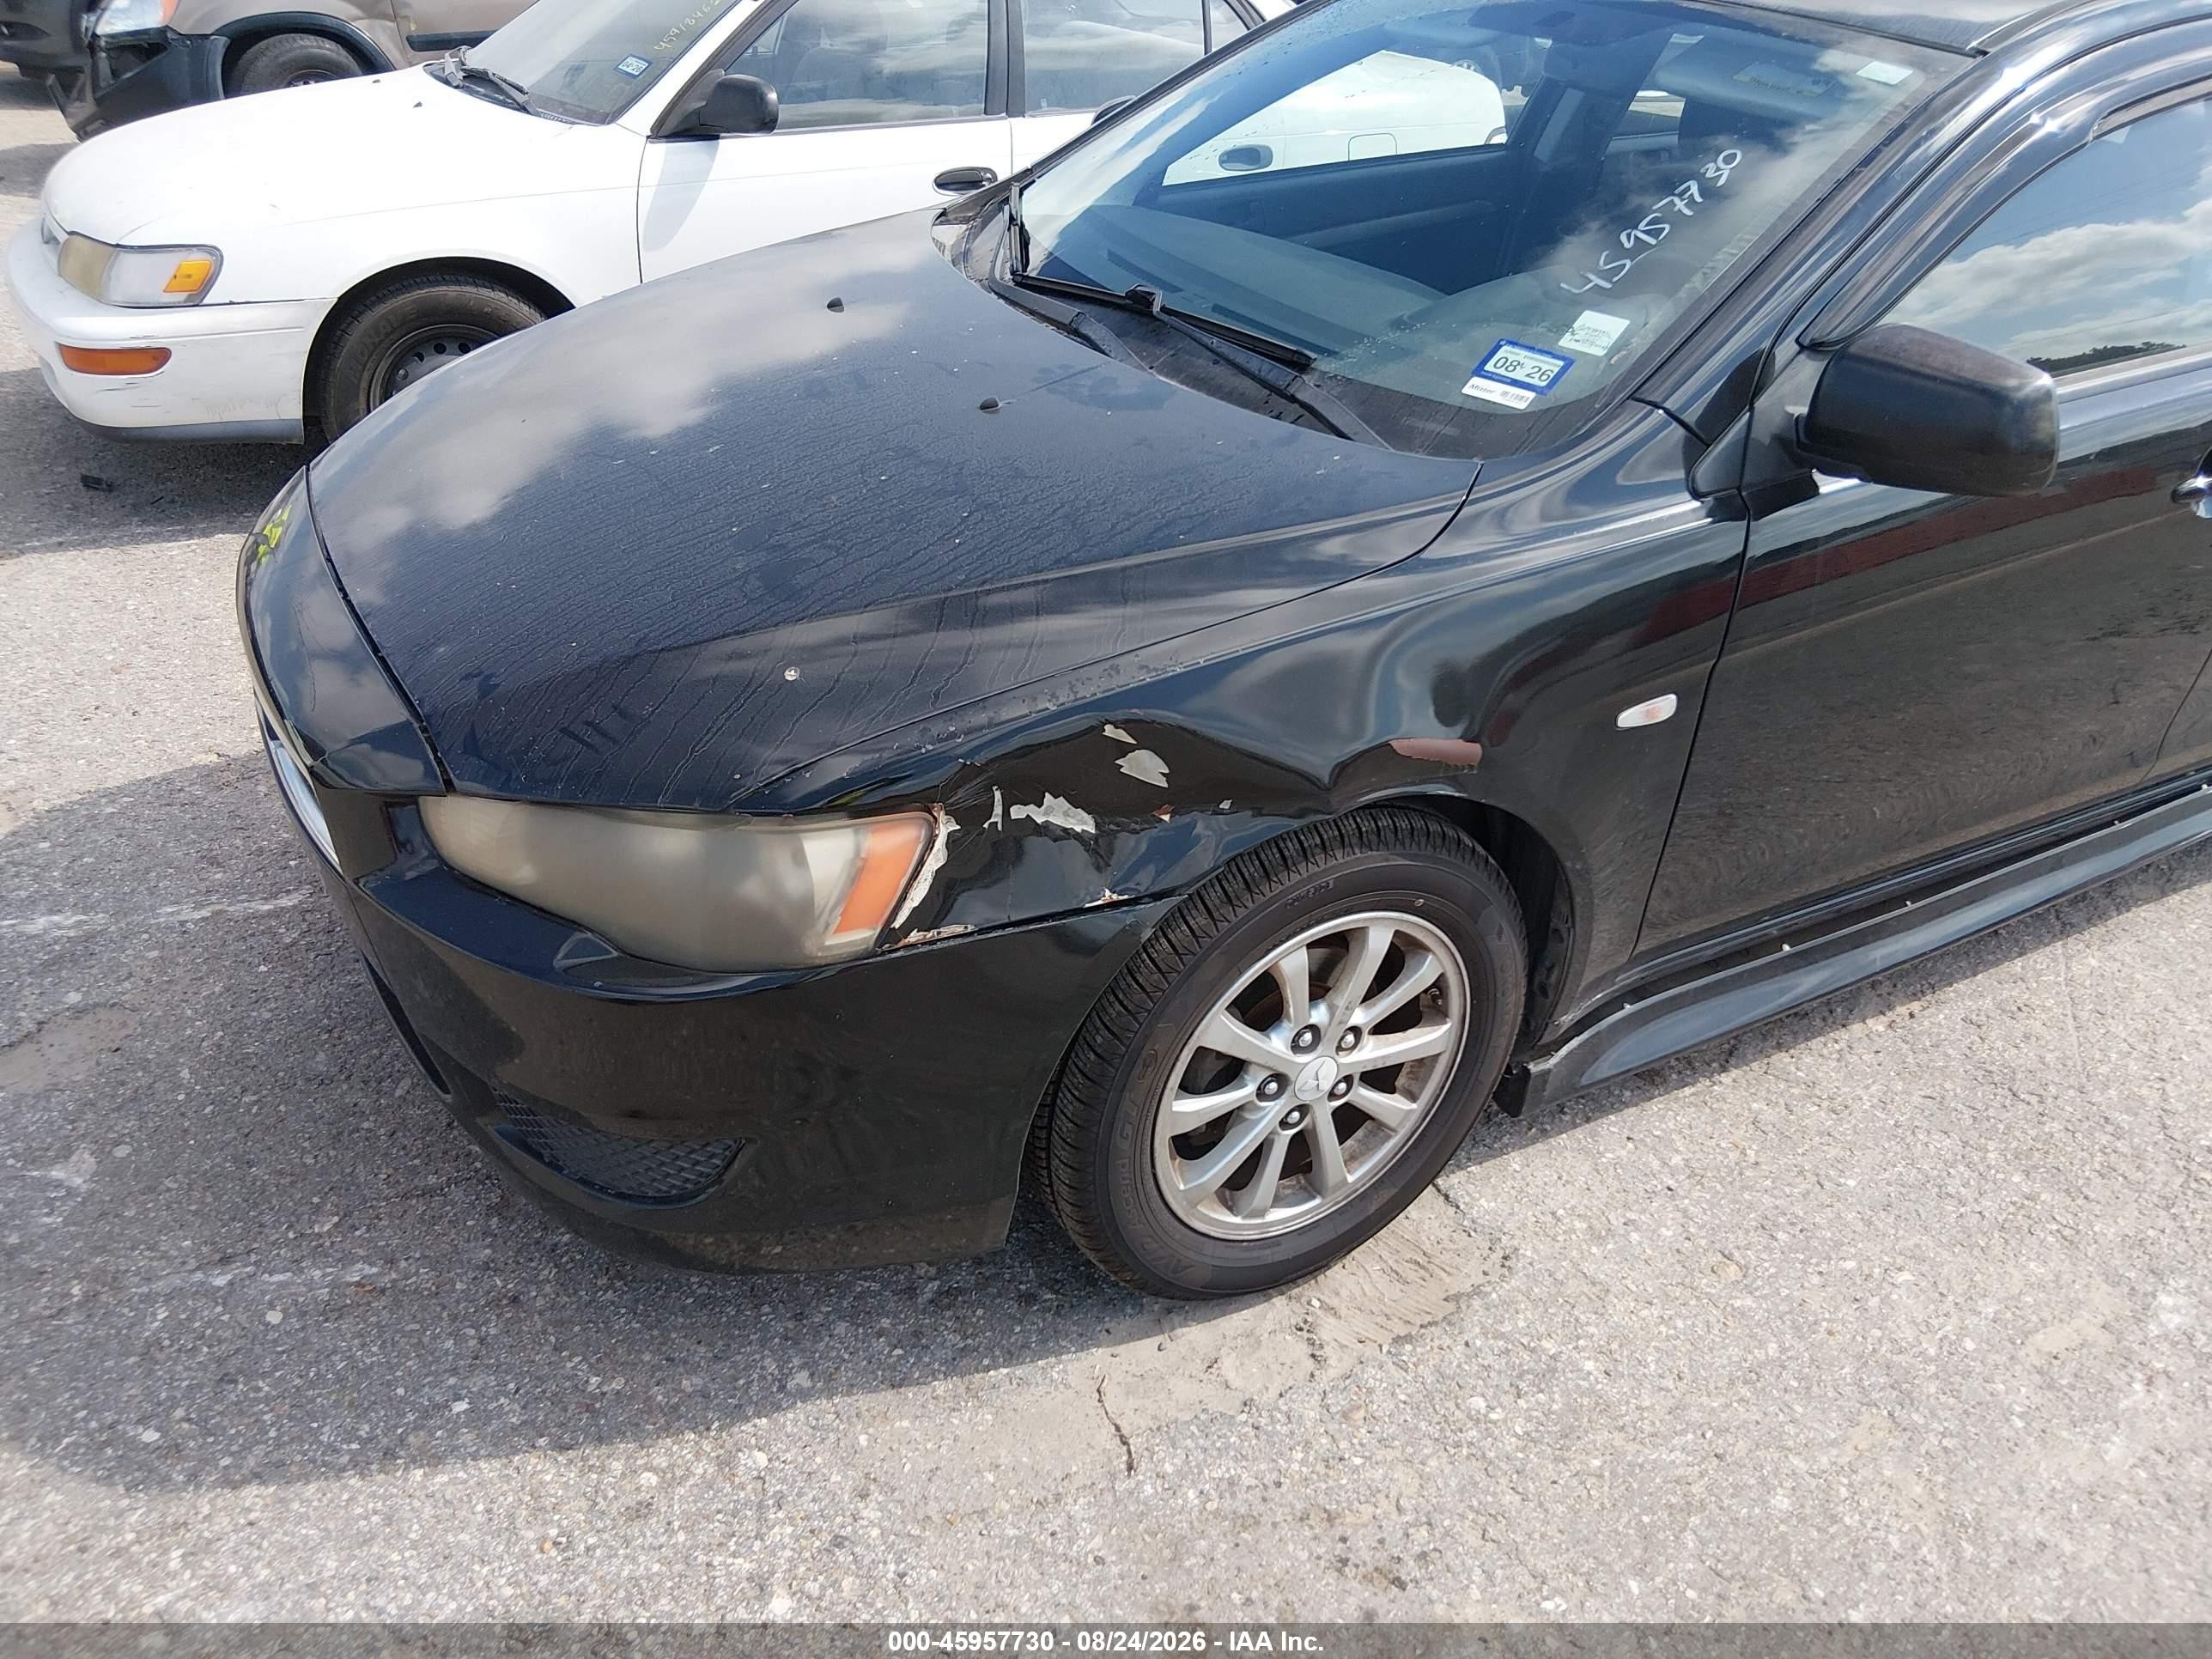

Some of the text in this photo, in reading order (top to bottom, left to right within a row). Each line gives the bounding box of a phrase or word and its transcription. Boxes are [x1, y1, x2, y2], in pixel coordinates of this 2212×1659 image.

[1560, 149, 1742, 295] 45957730
[1492, 356, 1521, 373] 08
[1524, 365, 1554, 382] 26
[1118, 1091, 1141, 1150] GT
[1117, 1158, 1145, 1230] Ascend
